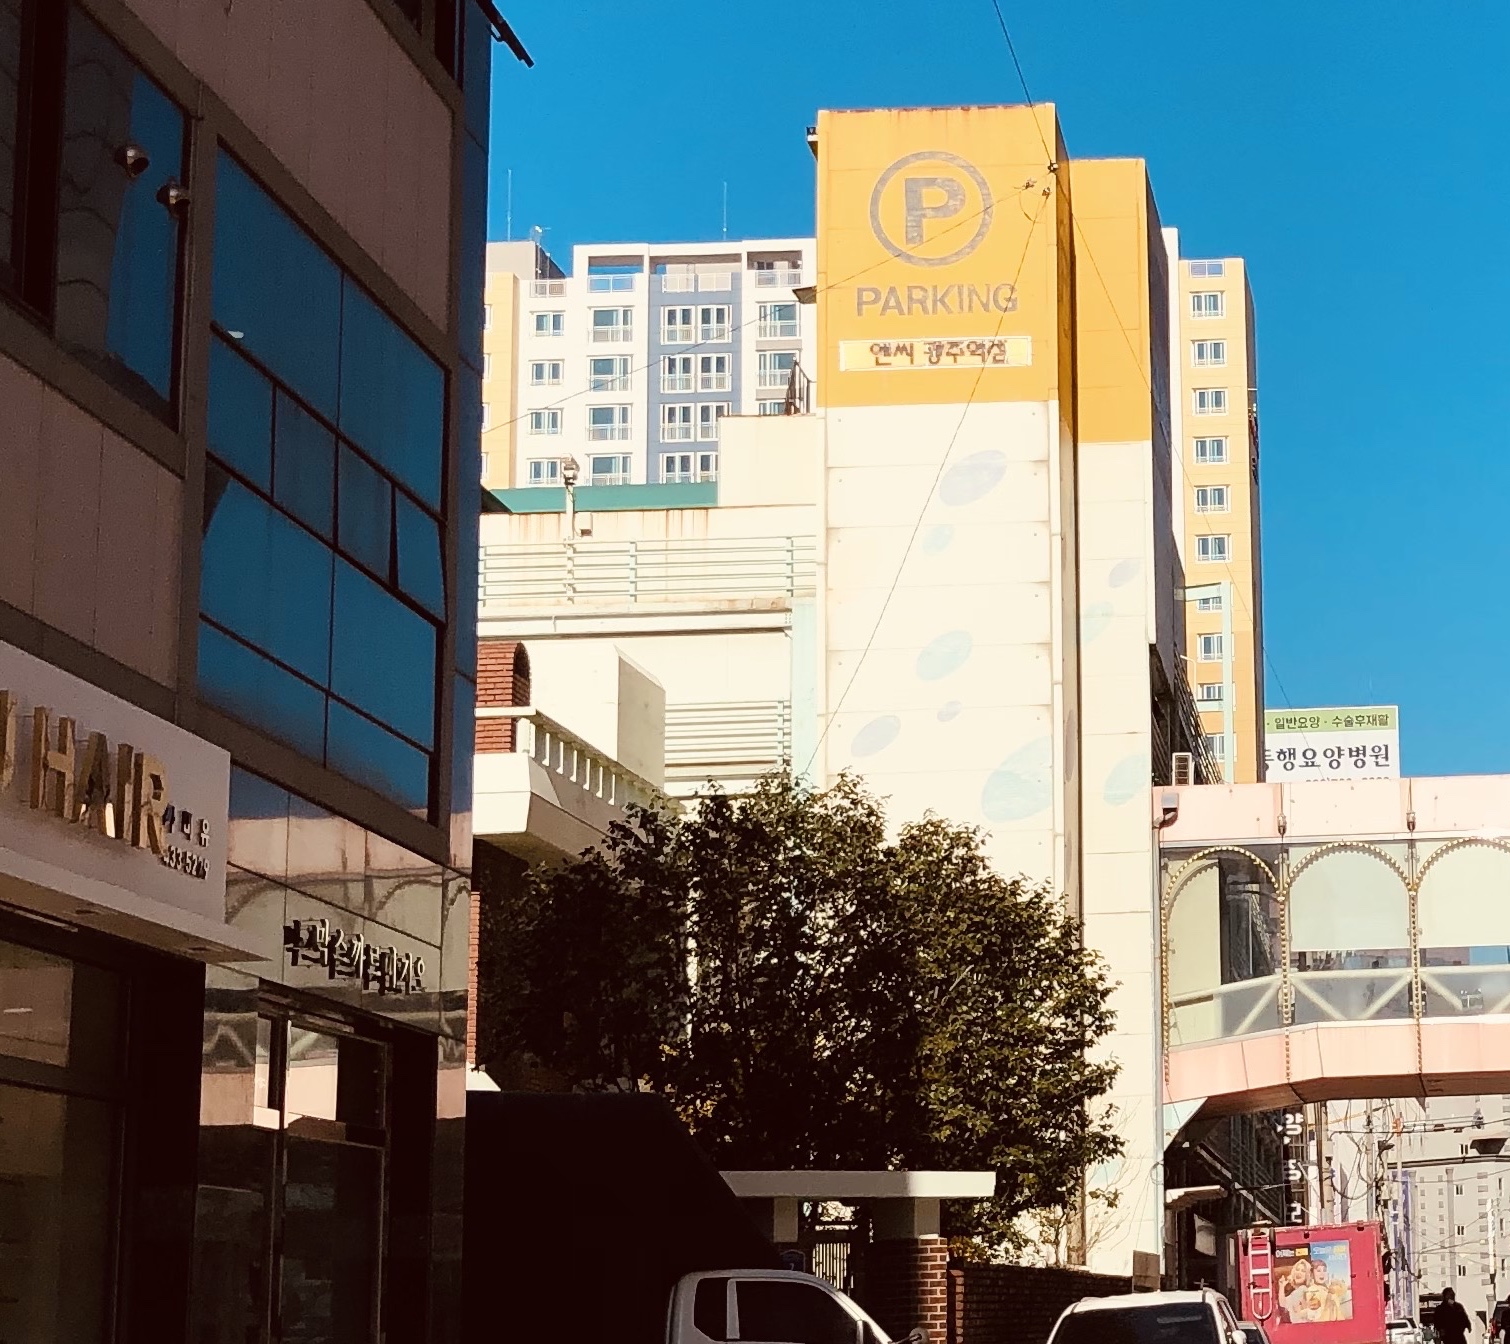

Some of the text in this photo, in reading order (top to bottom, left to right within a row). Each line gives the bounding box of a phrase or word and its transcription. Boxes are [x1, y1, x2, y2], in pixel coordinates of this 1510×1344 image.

[903, 177, 967, 247] P
[856, 282, 1019, 317] PARKING
[1274, 713, 1390, 730] 일반요양 수술후재활
[29, 704, 170, 856] HAIR
